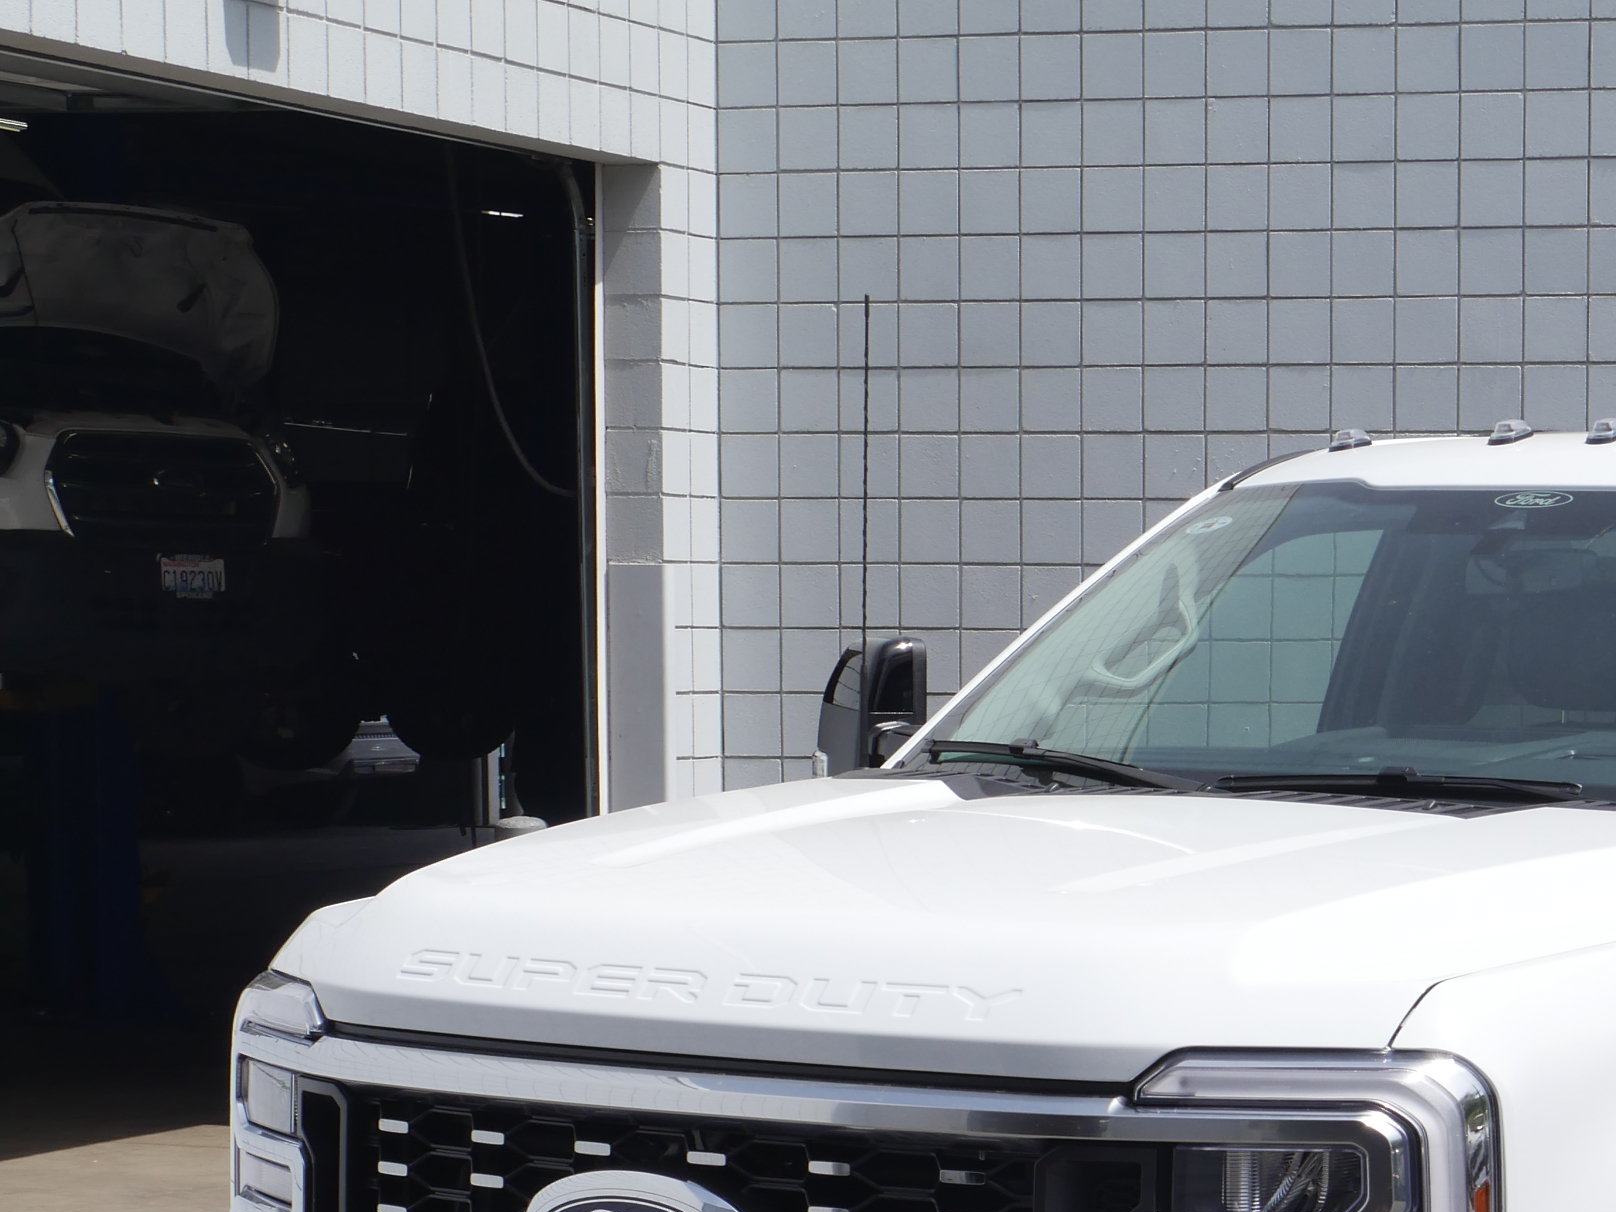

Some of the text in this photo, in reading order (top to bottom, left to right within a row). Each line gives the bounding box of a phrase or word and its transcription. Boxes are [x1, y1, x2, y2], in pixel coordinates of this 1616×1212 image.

[1505, 493, 1561, 506] Ford
[396, 947, 1025, 1022] SUPER DUTY
